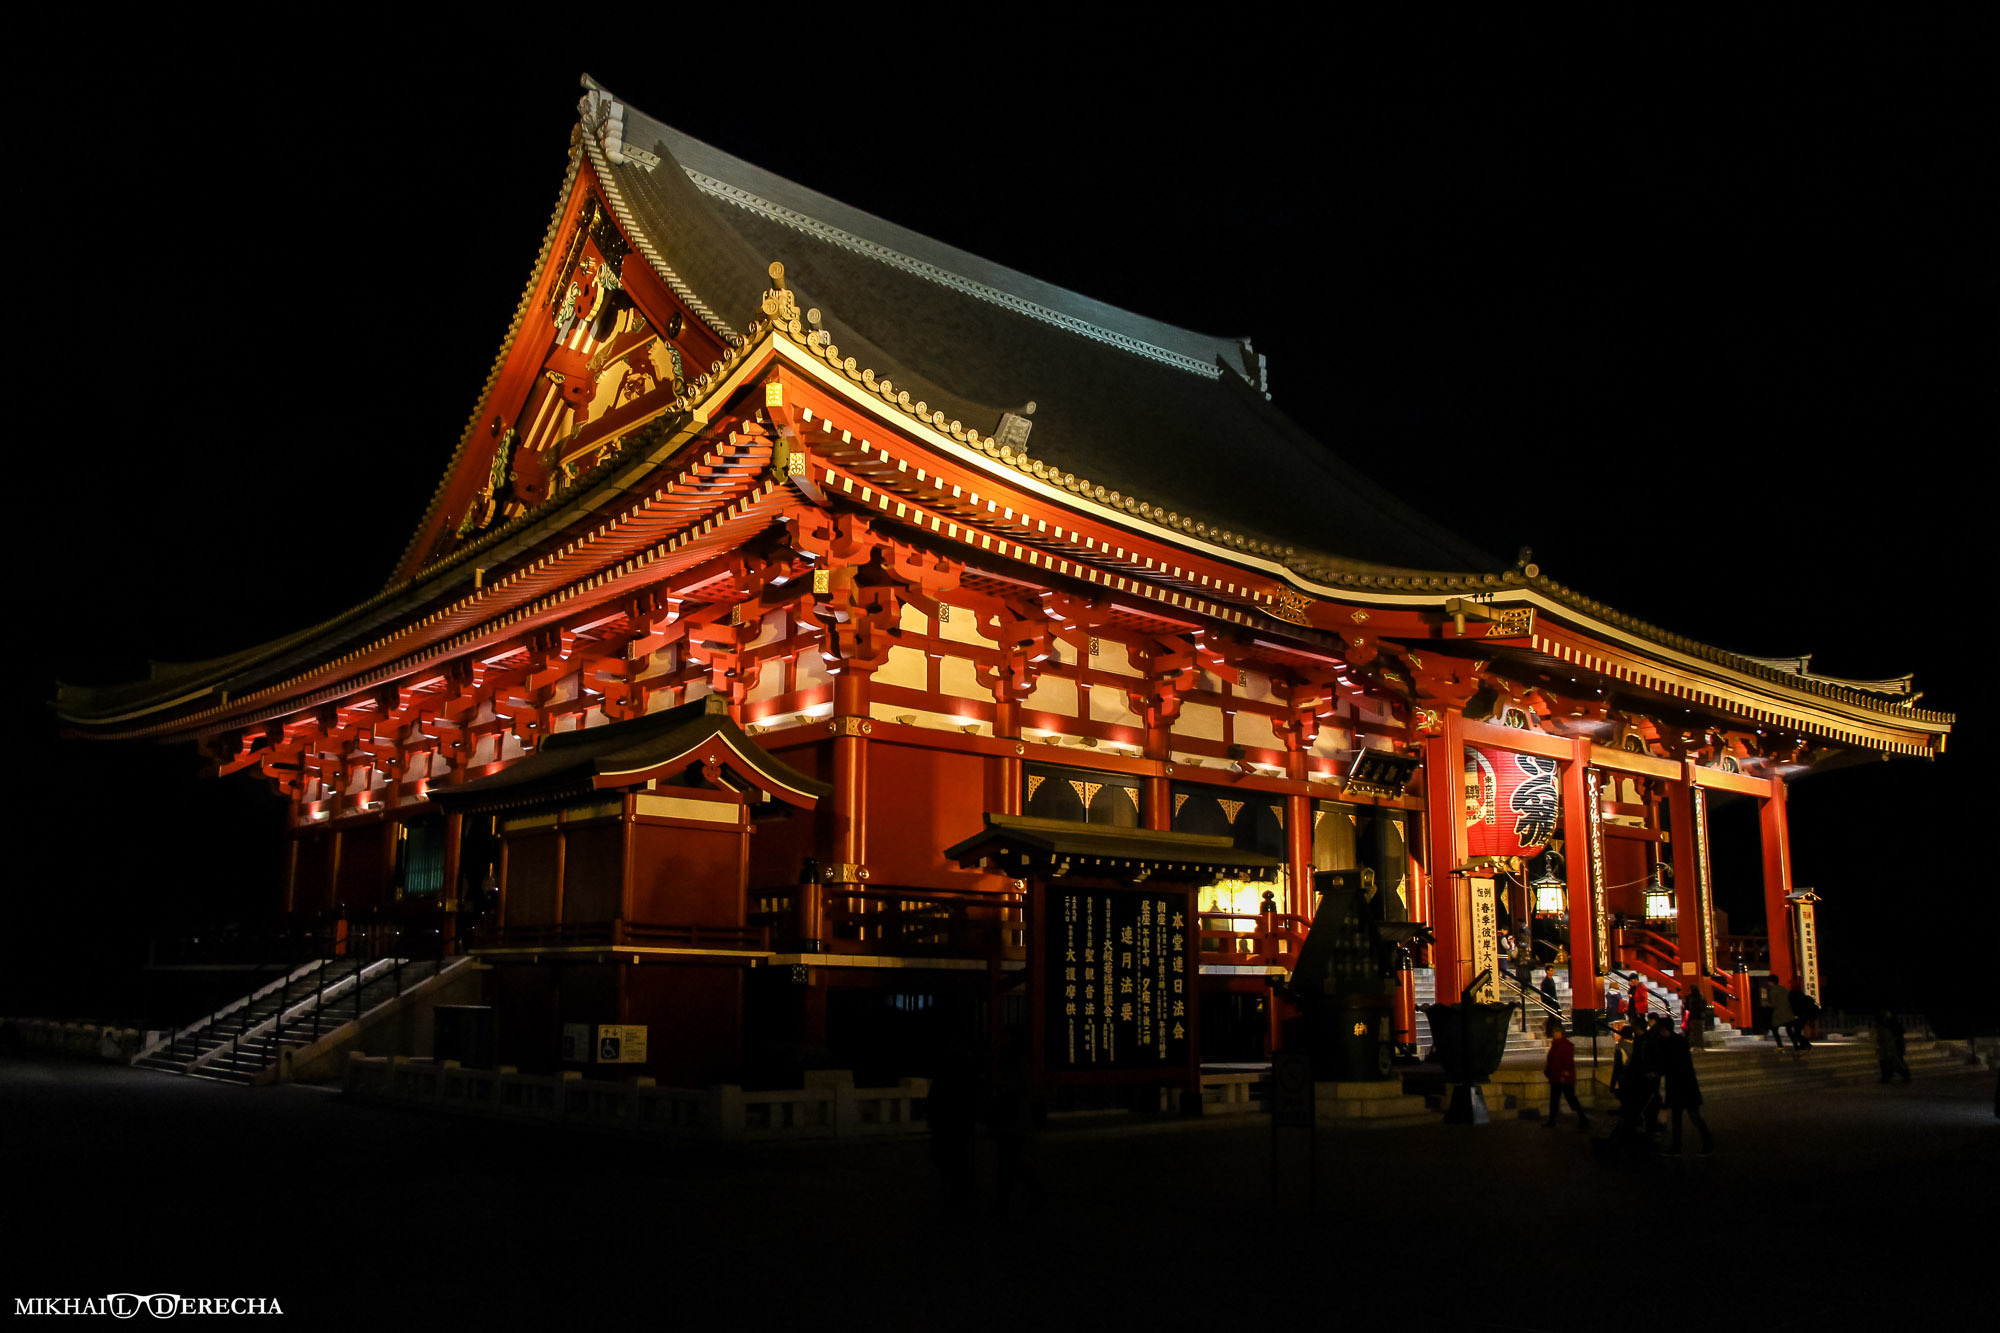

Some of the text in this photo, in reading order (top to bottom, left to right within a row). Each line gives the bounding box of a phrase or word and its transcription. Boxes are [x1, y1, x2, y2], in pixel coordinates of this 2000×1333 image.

[1476, 887, 1491, 898] 恒例
[1120, 925, 1134, 1022] 連月法要
[1172, 911, 1185, 1039] 本堂連日法会
[1481, 902, 1494, 1003] 春季彼岸大法執
